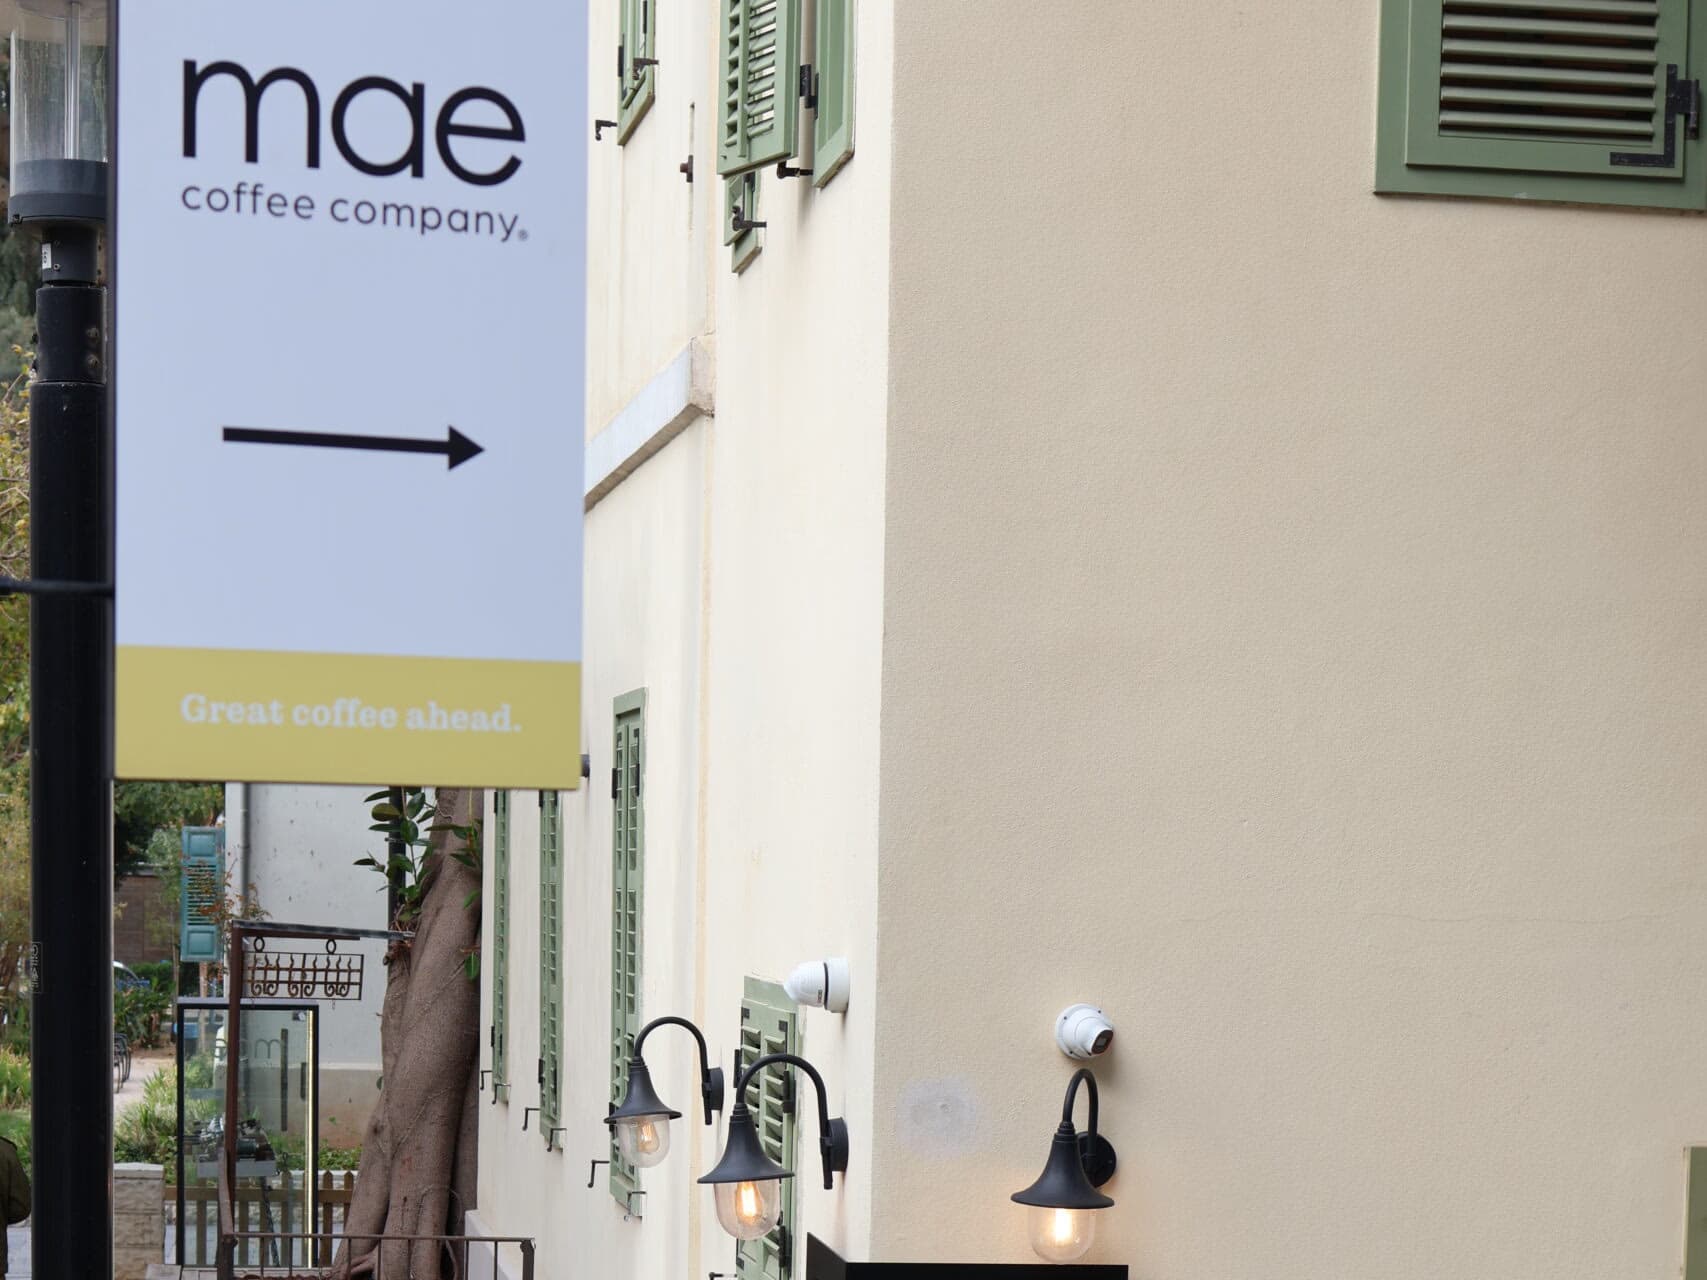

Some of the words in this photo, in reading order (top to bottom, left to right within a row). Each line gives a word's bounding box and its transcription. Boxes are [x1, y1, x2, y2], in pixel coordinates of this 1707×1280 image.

[182, 59, 527, 186] mae
[181, 182, 316, 220] coffee
[181, 693, 284, 727] Great
[291, 697, 398, 730] coffee
[405, 701, 522, 734] ahead.
